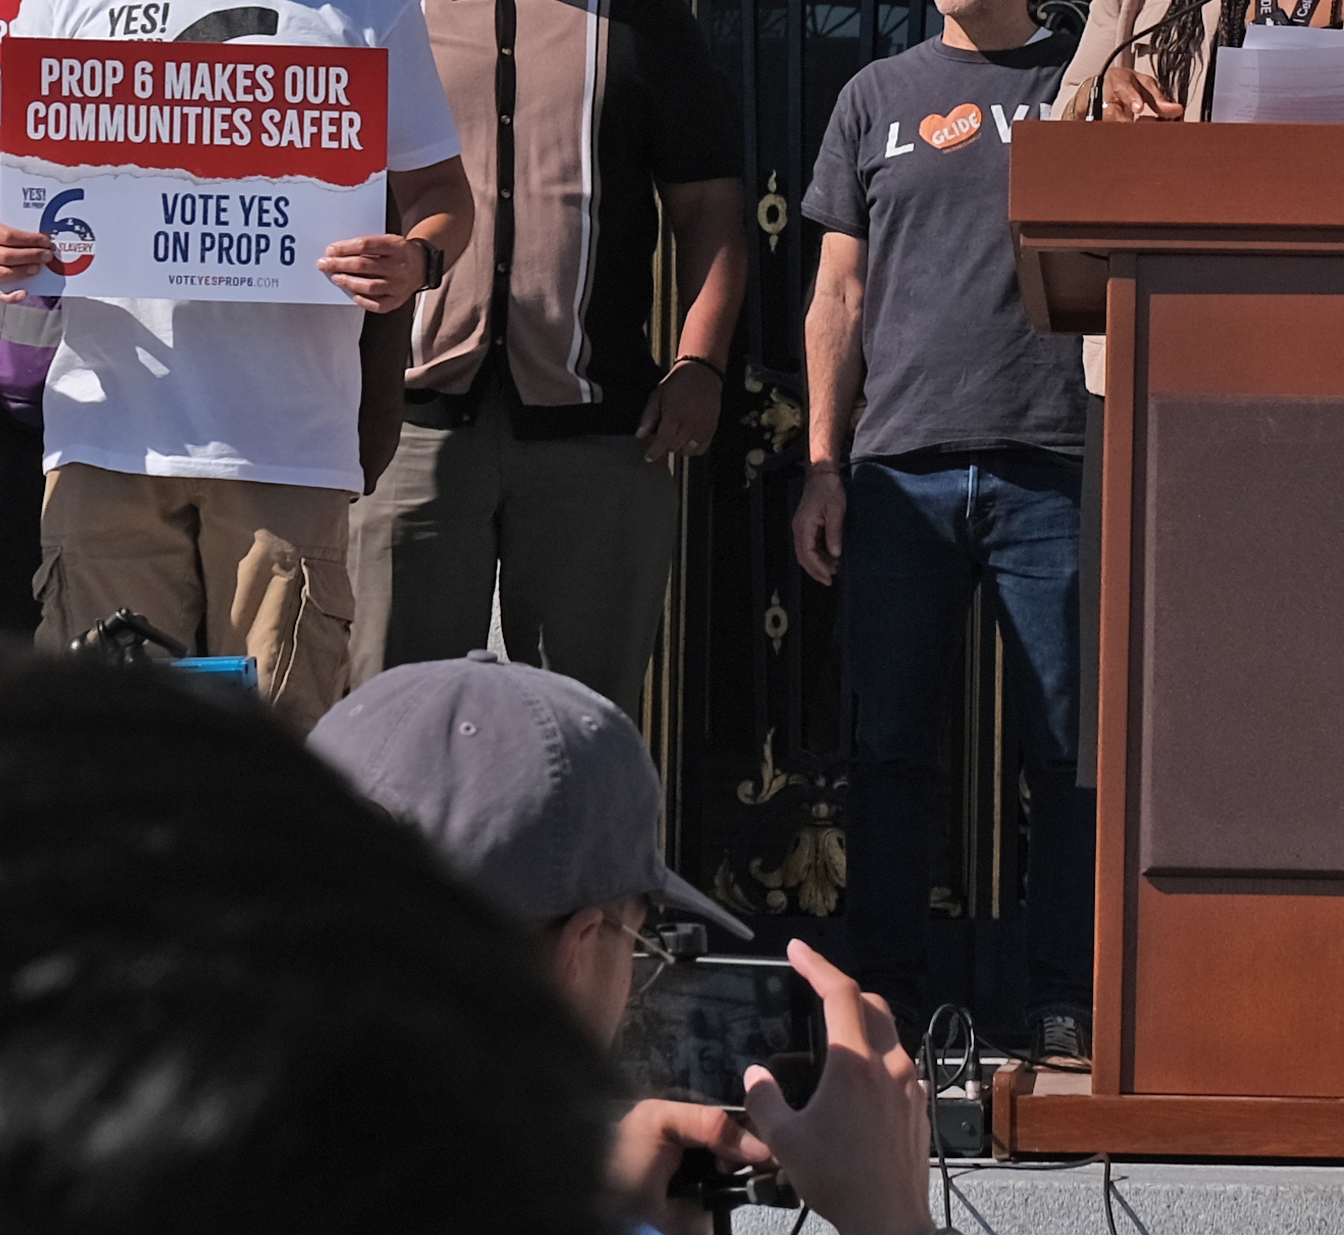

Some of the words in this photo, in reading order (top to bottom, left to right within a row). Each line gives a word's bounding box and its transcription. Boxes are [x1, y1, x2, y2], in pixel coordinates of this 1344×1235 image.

[108, 2, 170, 37] YES!
[41, 58, 124, 99] PROP
[134, 61, 153, 100] 6
[165, 62, 275, 103] MAKES
[284, 65, 351, 106] OUR
[26, 101, 252, 147] COMMUNITIES
[261, 108, 363, 150] SAFER
[932, 111, 981, 145] GLIDE
[22, 187, 46, 201] YES!
[161, 192, 229, 227] VOTE
[238, 194, 290, 228] YES
[153, 231, 195, 264] ON
[200, 232, 269, 266] PROP
[280, 232, 296, 266] 6
[168, 274, 280, 289] VOTEYESPROP6.COM
